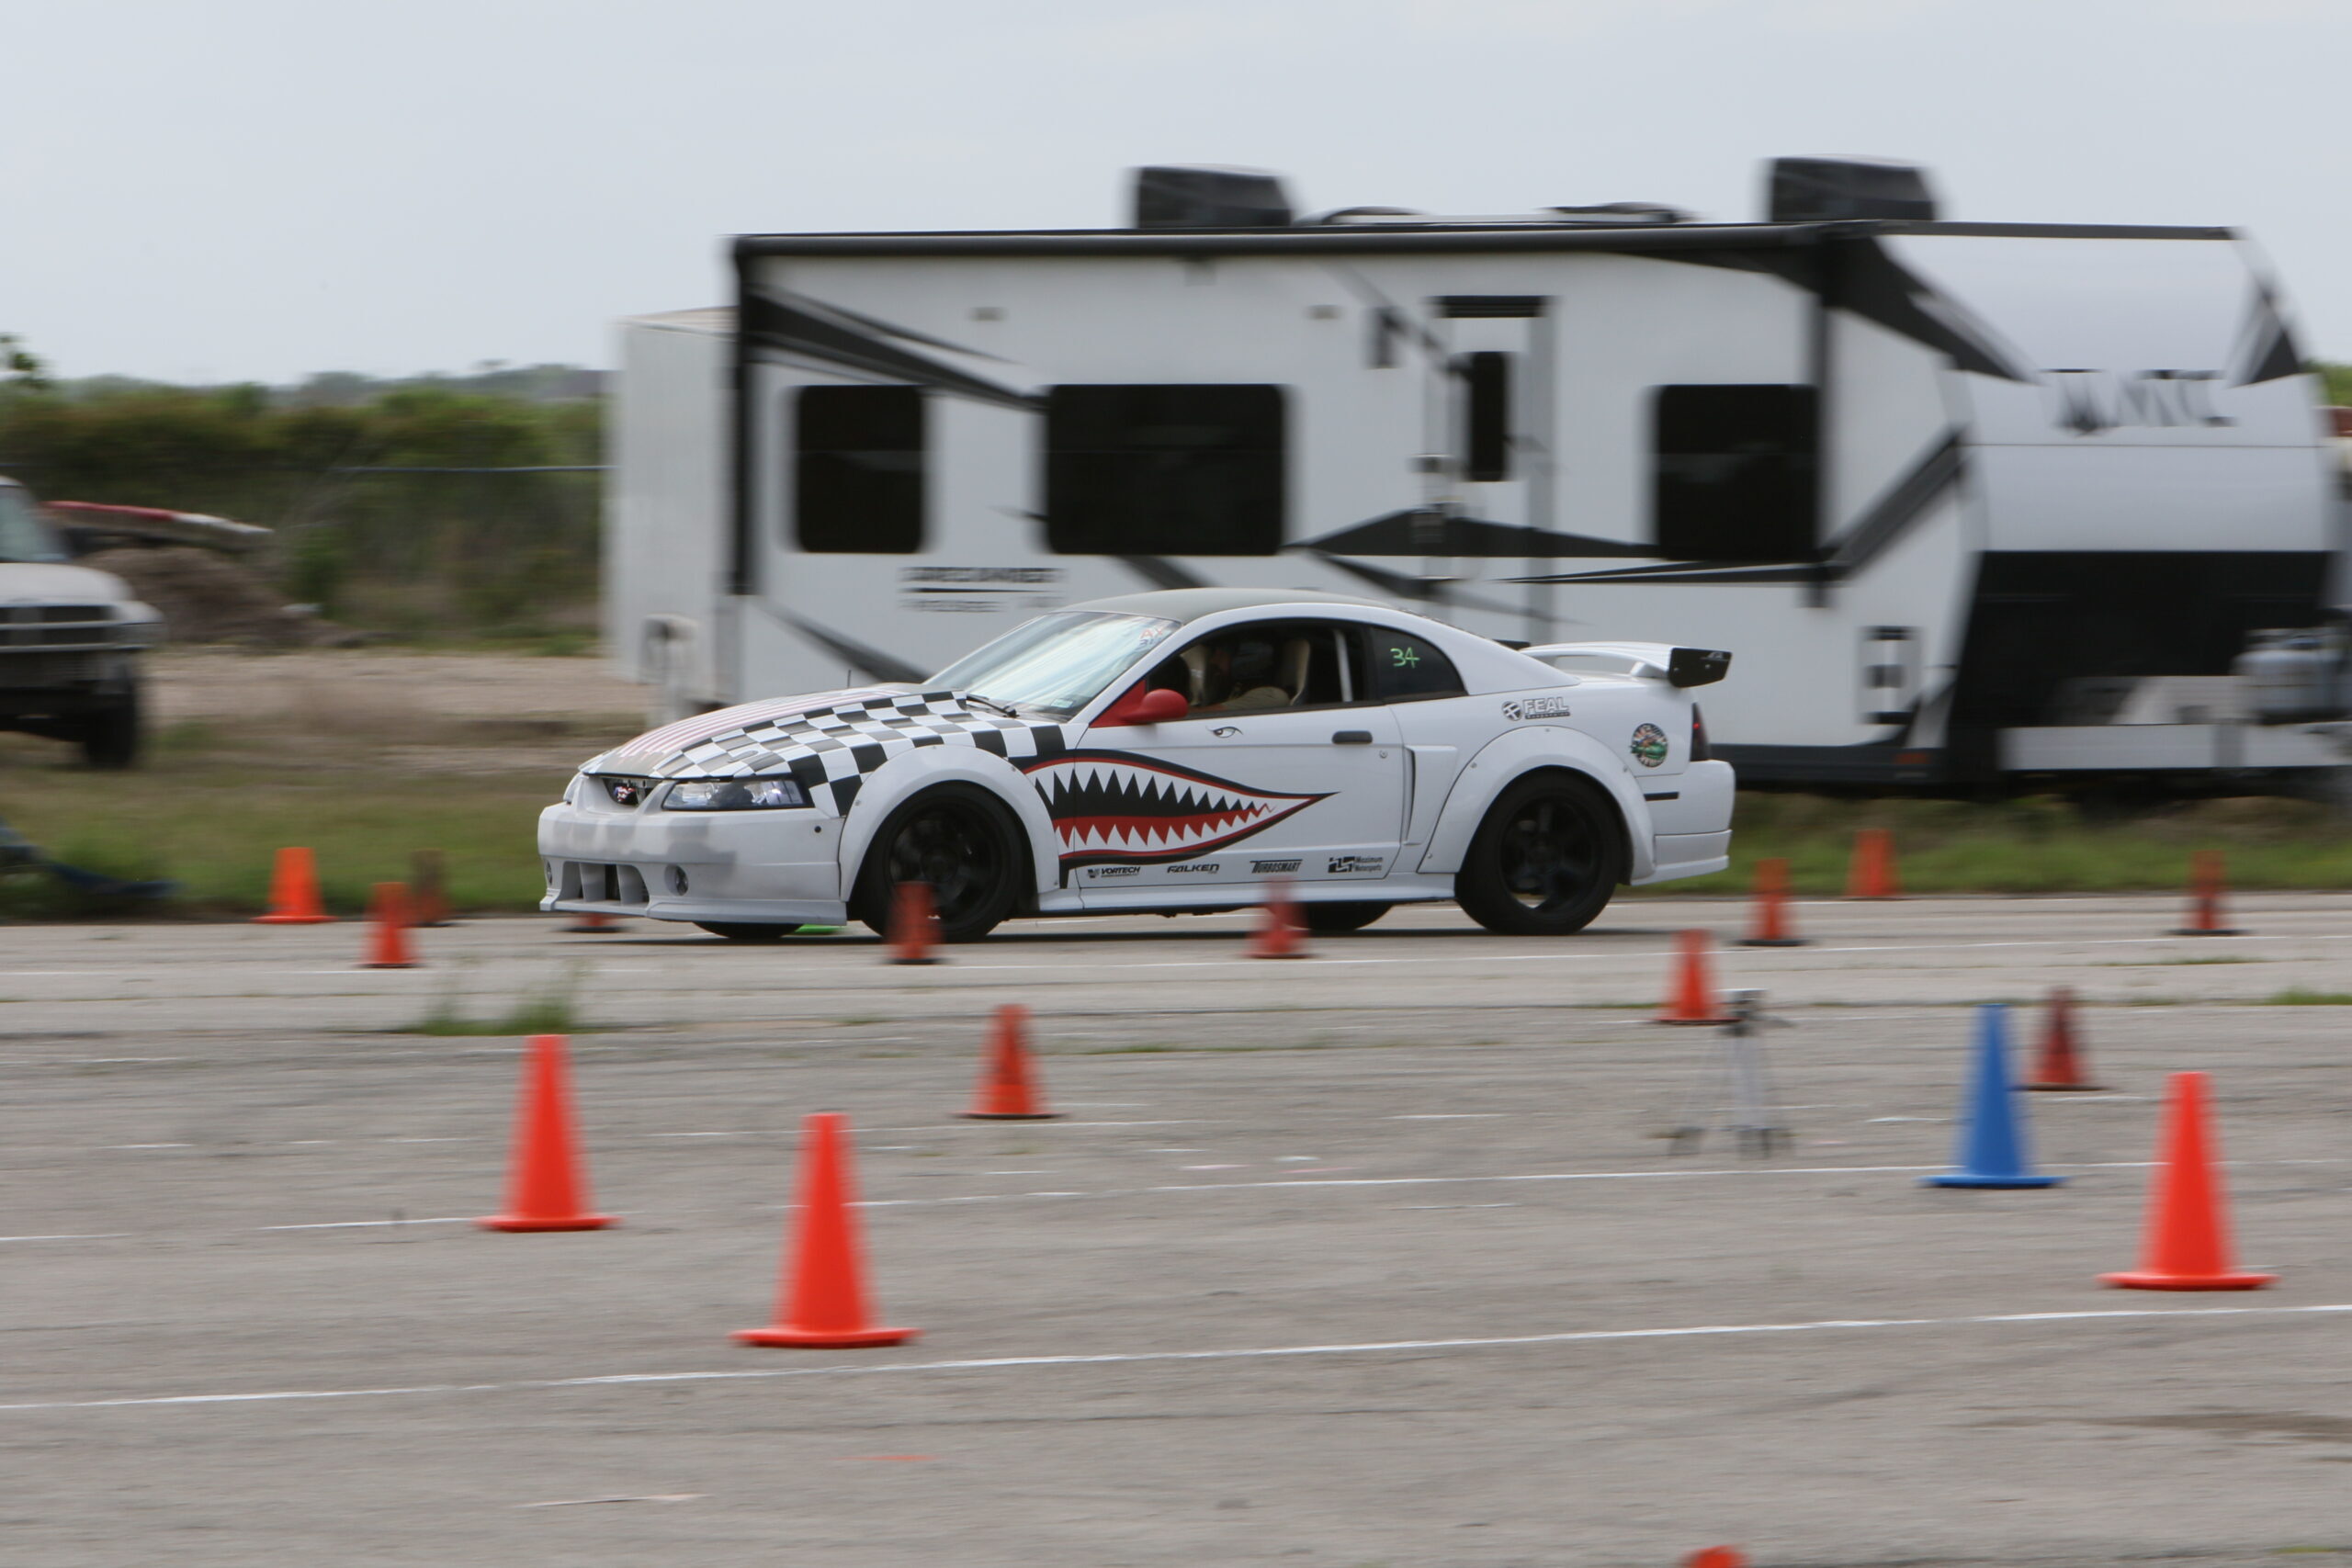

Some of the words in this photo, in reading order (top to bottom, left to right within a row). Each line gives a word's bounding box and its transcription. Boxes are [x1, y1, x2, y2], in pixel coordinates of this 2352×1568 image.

[1390, 647, 1420, 669] 34
[1522, 696, 1569, 714] FEAL
[1102, 866, 1140, 874] VORTECH
[1167, 863, 1219, 874] FALKEN
